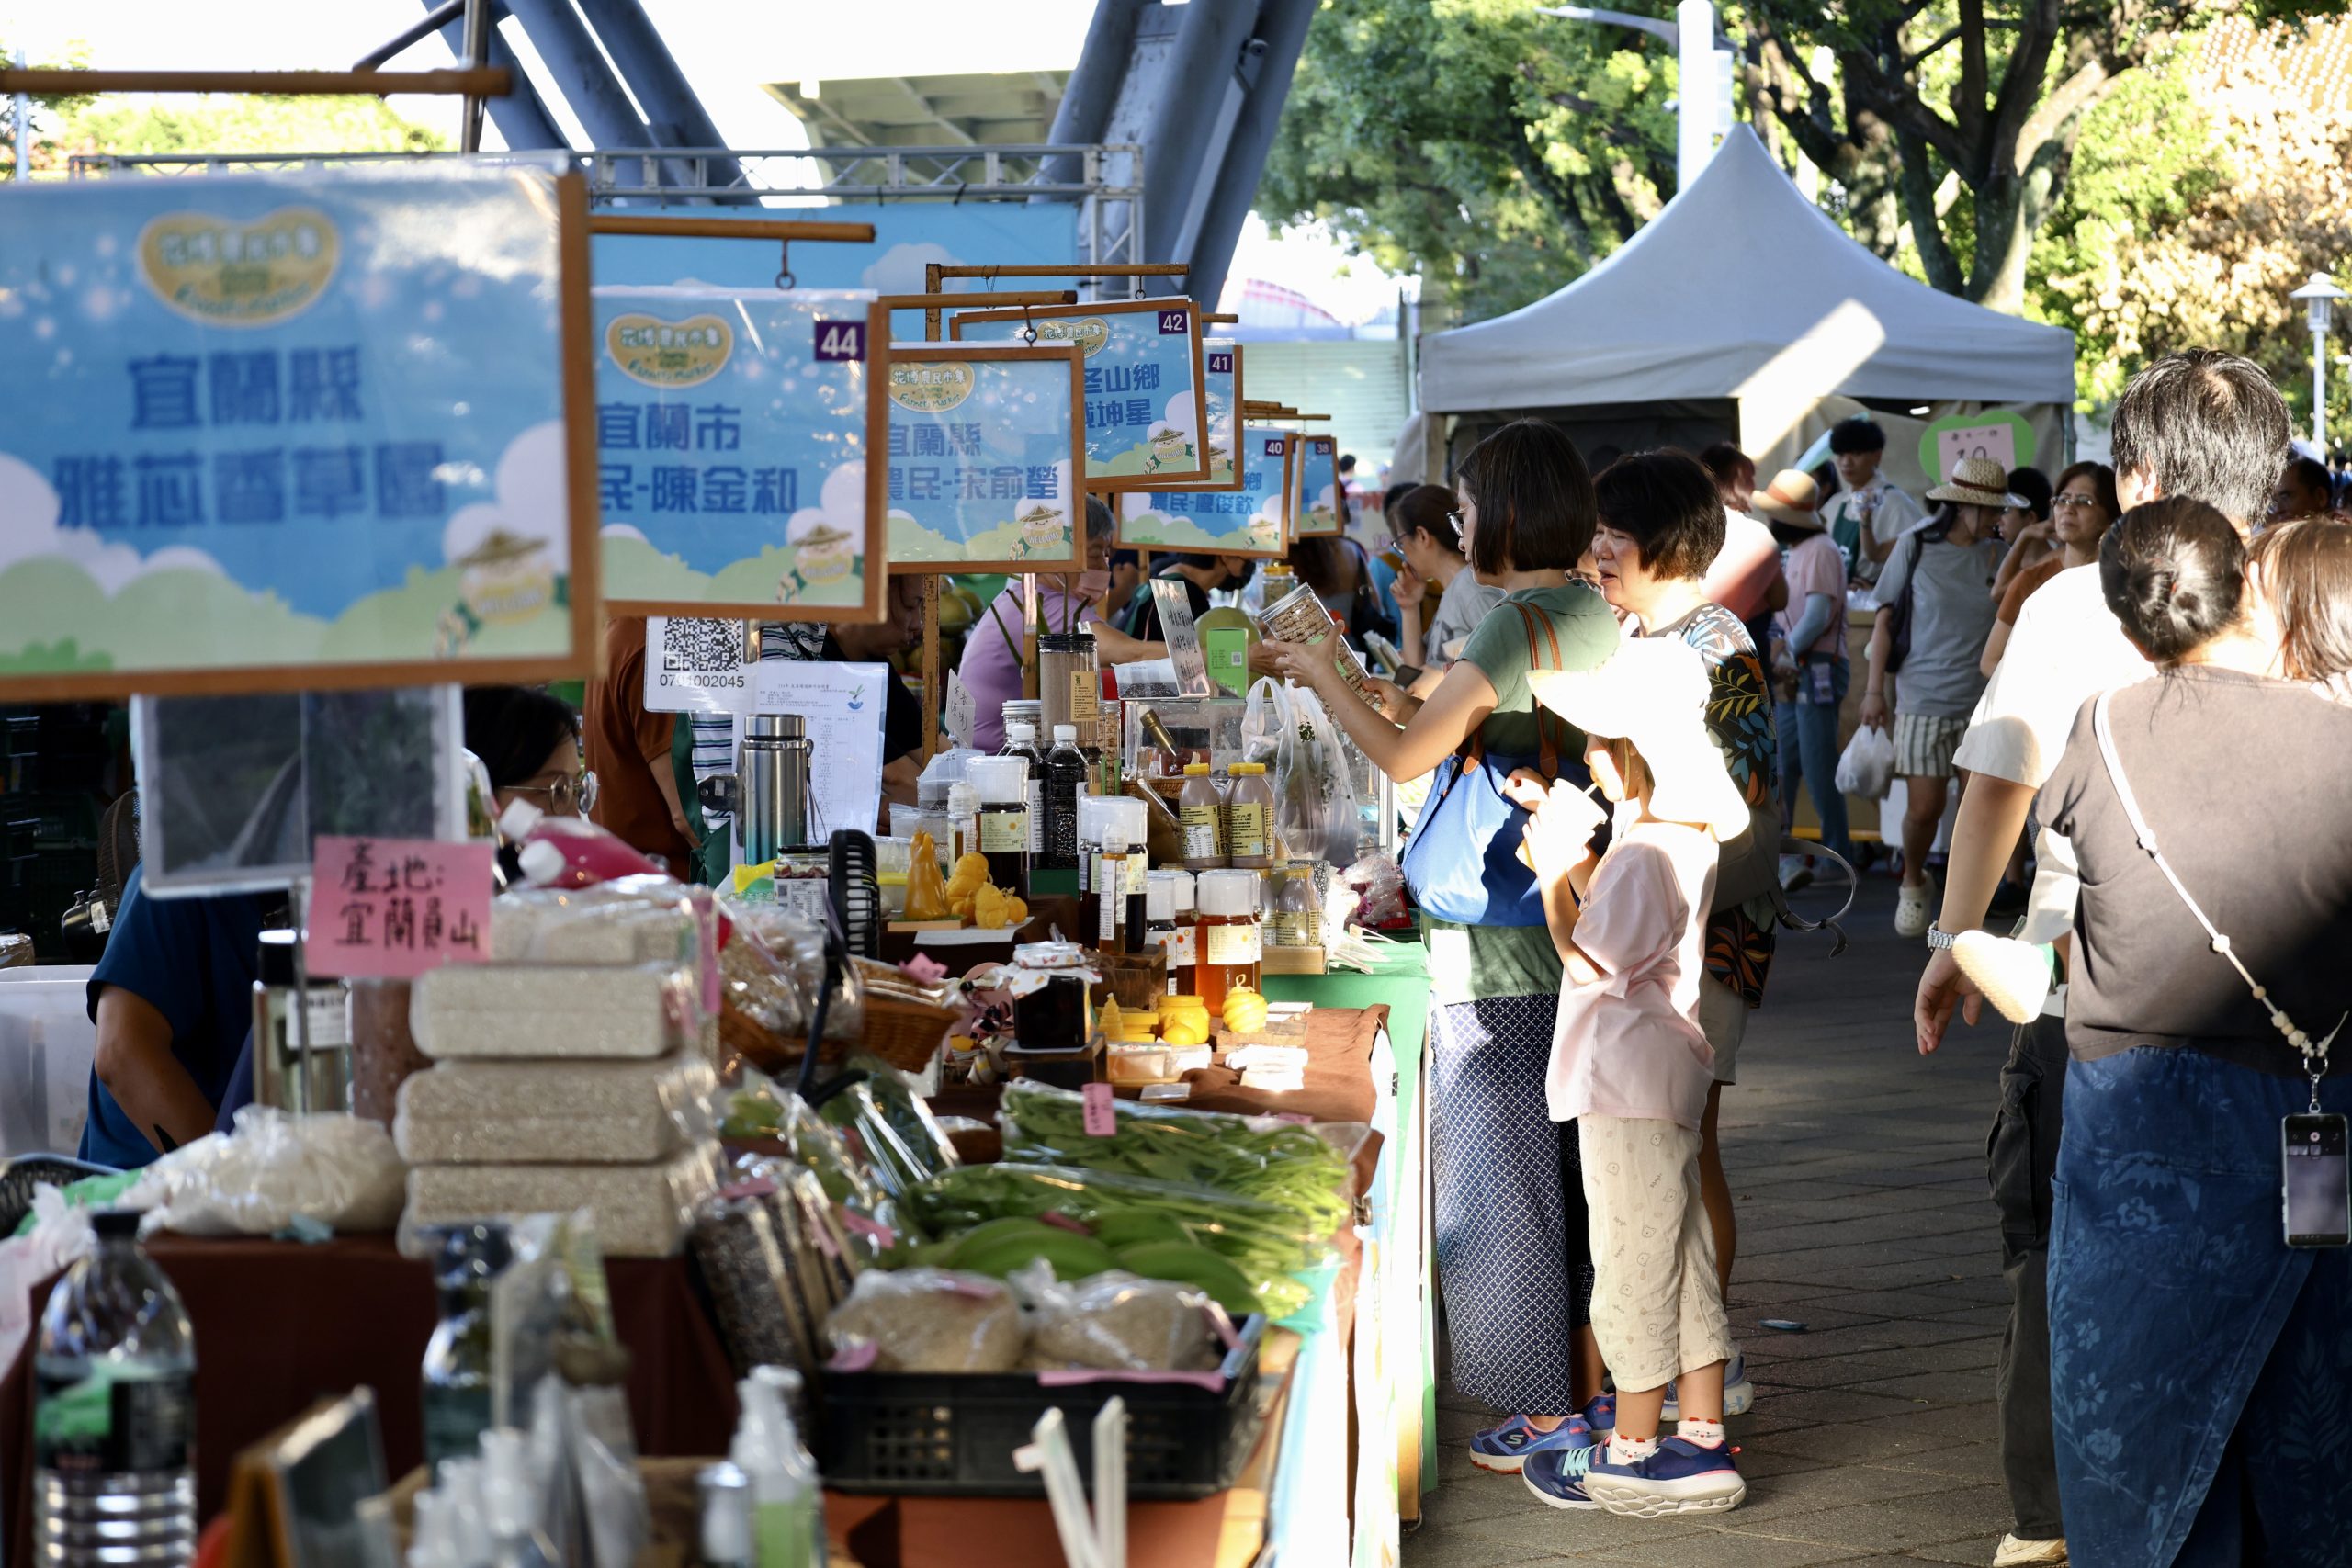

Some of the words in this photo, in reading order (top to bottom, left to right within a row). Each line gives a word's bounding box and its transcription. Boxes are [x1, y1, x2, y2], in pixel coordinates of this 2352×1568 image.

[1162, 314, 1183, 331] 42
[820, 326, 858, 356] 44
[1212, 356, 1227, 370] 41
[598, 402, 741, 451] 宜蘭市
[888, 423, 981, 457] 宜蘭縣
[1267, 441, 1283, 454] 40
[1317, 443, 1329, 453] 38
[1028, 531, 1060, 544] WELCOME
